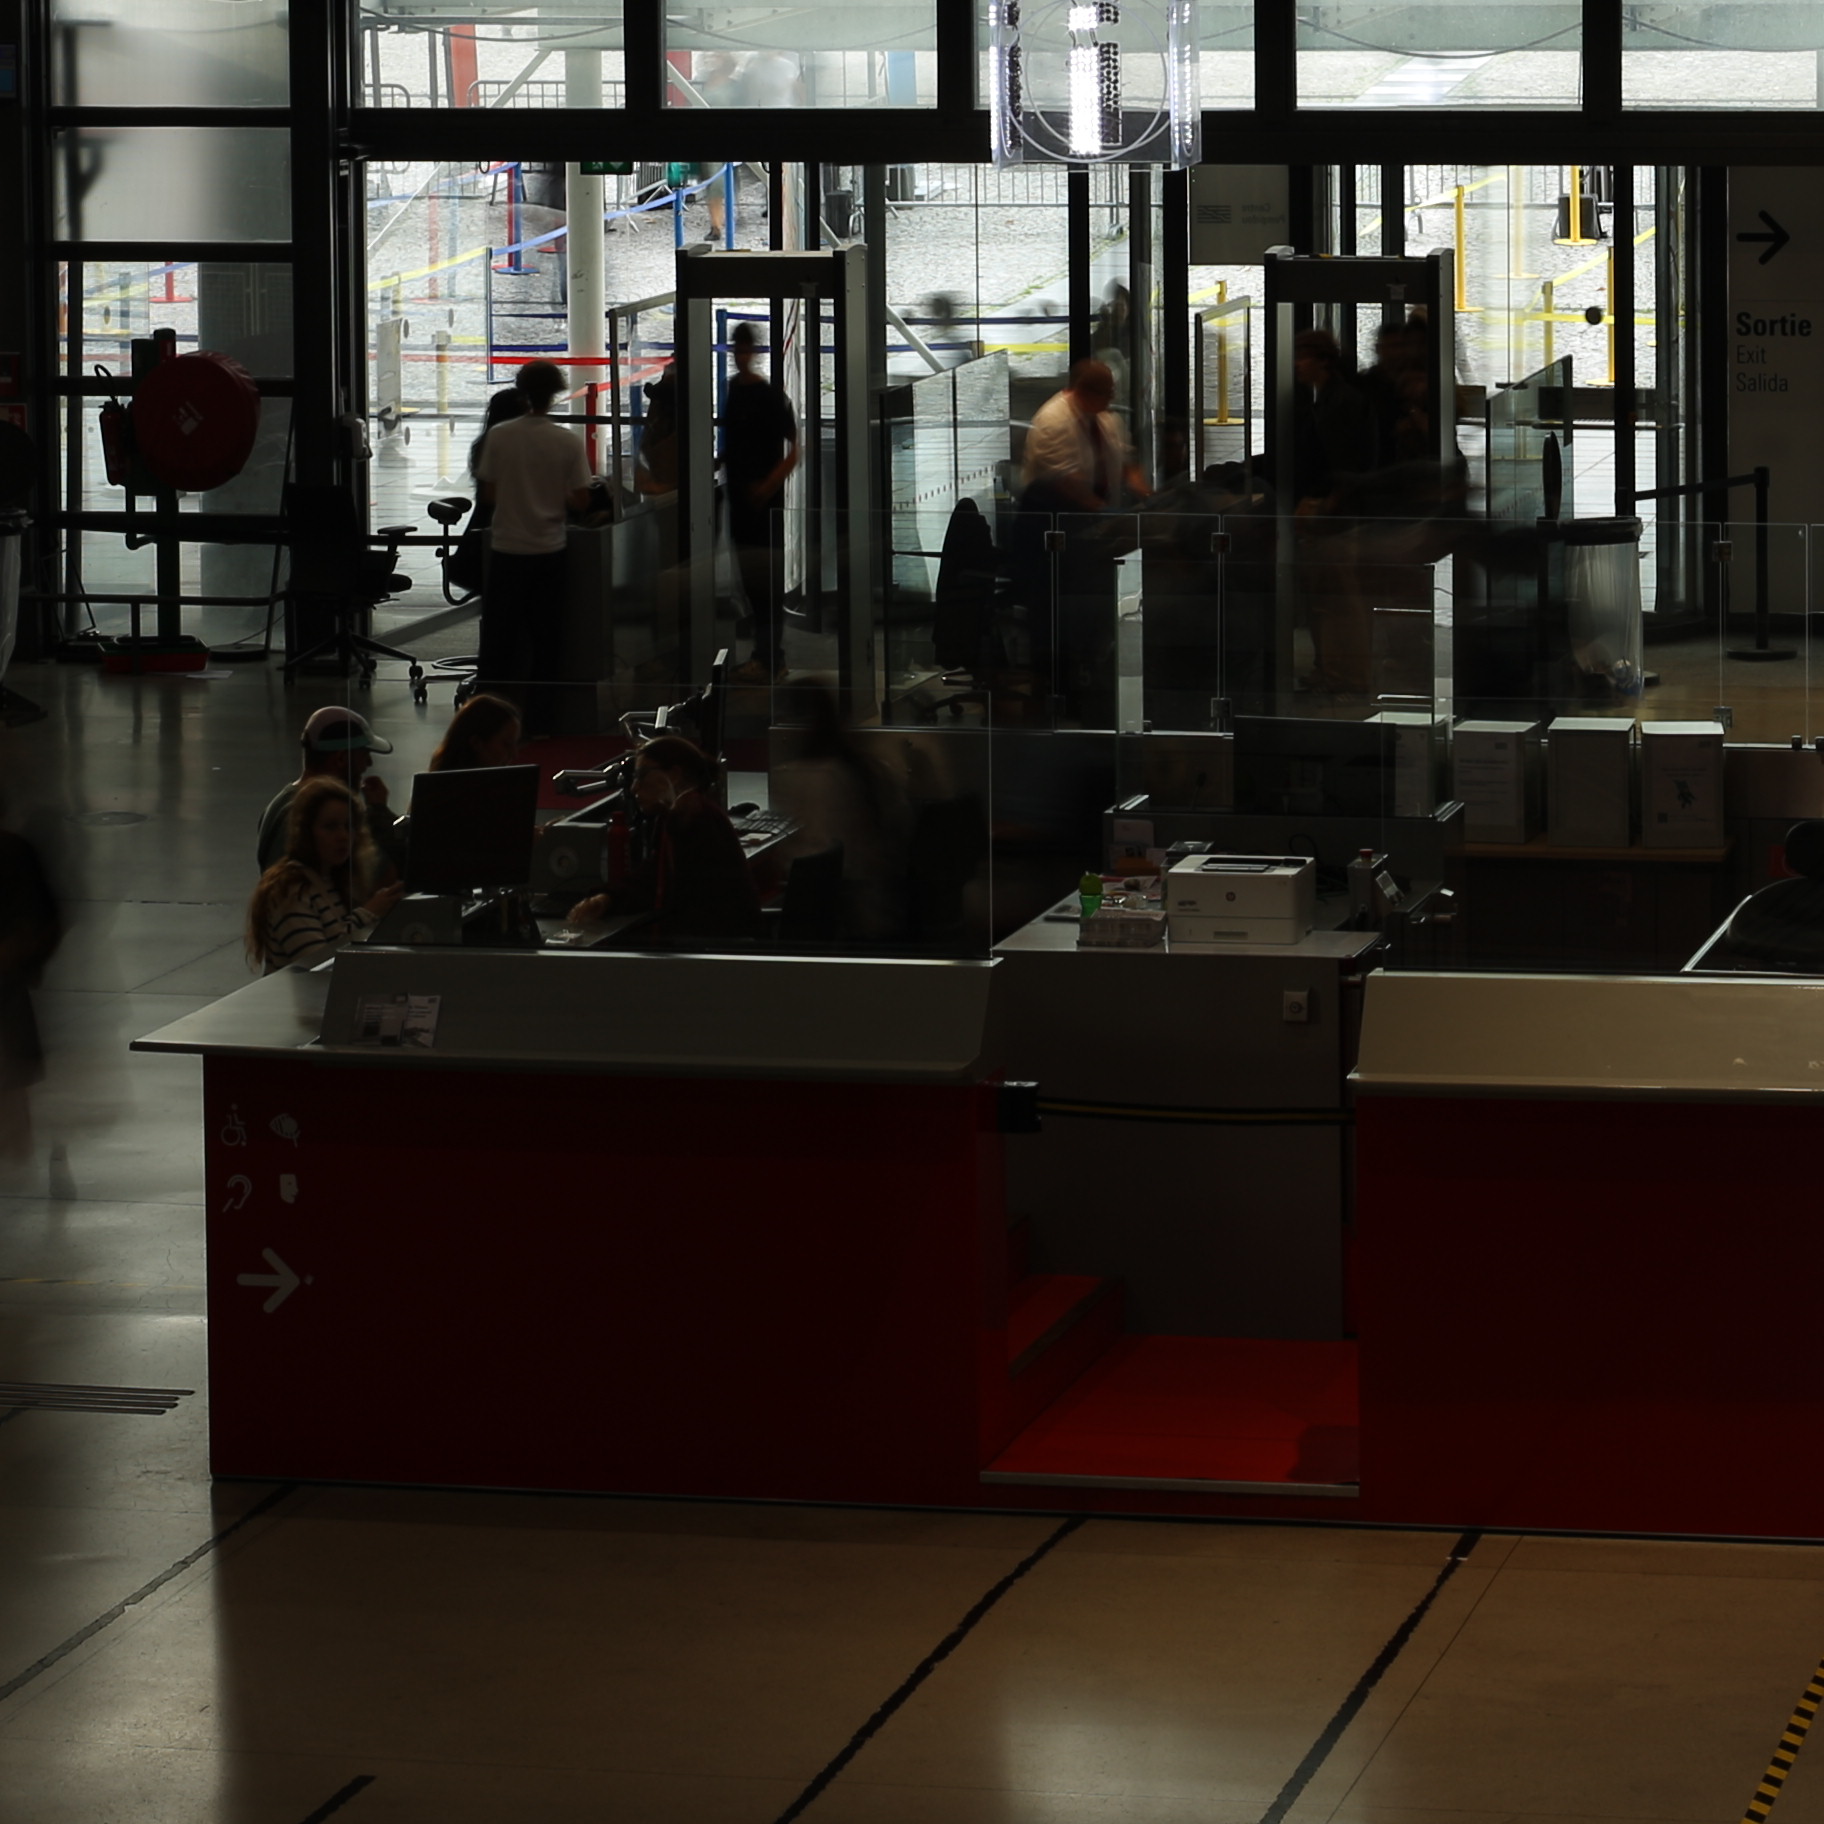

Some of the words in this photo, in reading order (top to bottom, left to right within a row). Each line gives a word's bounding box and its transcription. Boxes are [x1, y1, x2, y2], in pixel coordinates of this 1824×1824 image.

[1736, 312, 1812, 337] Sortie
[1737, 345, 1767, 364] Exit
[1736, 372, 1789, 392] Salida
